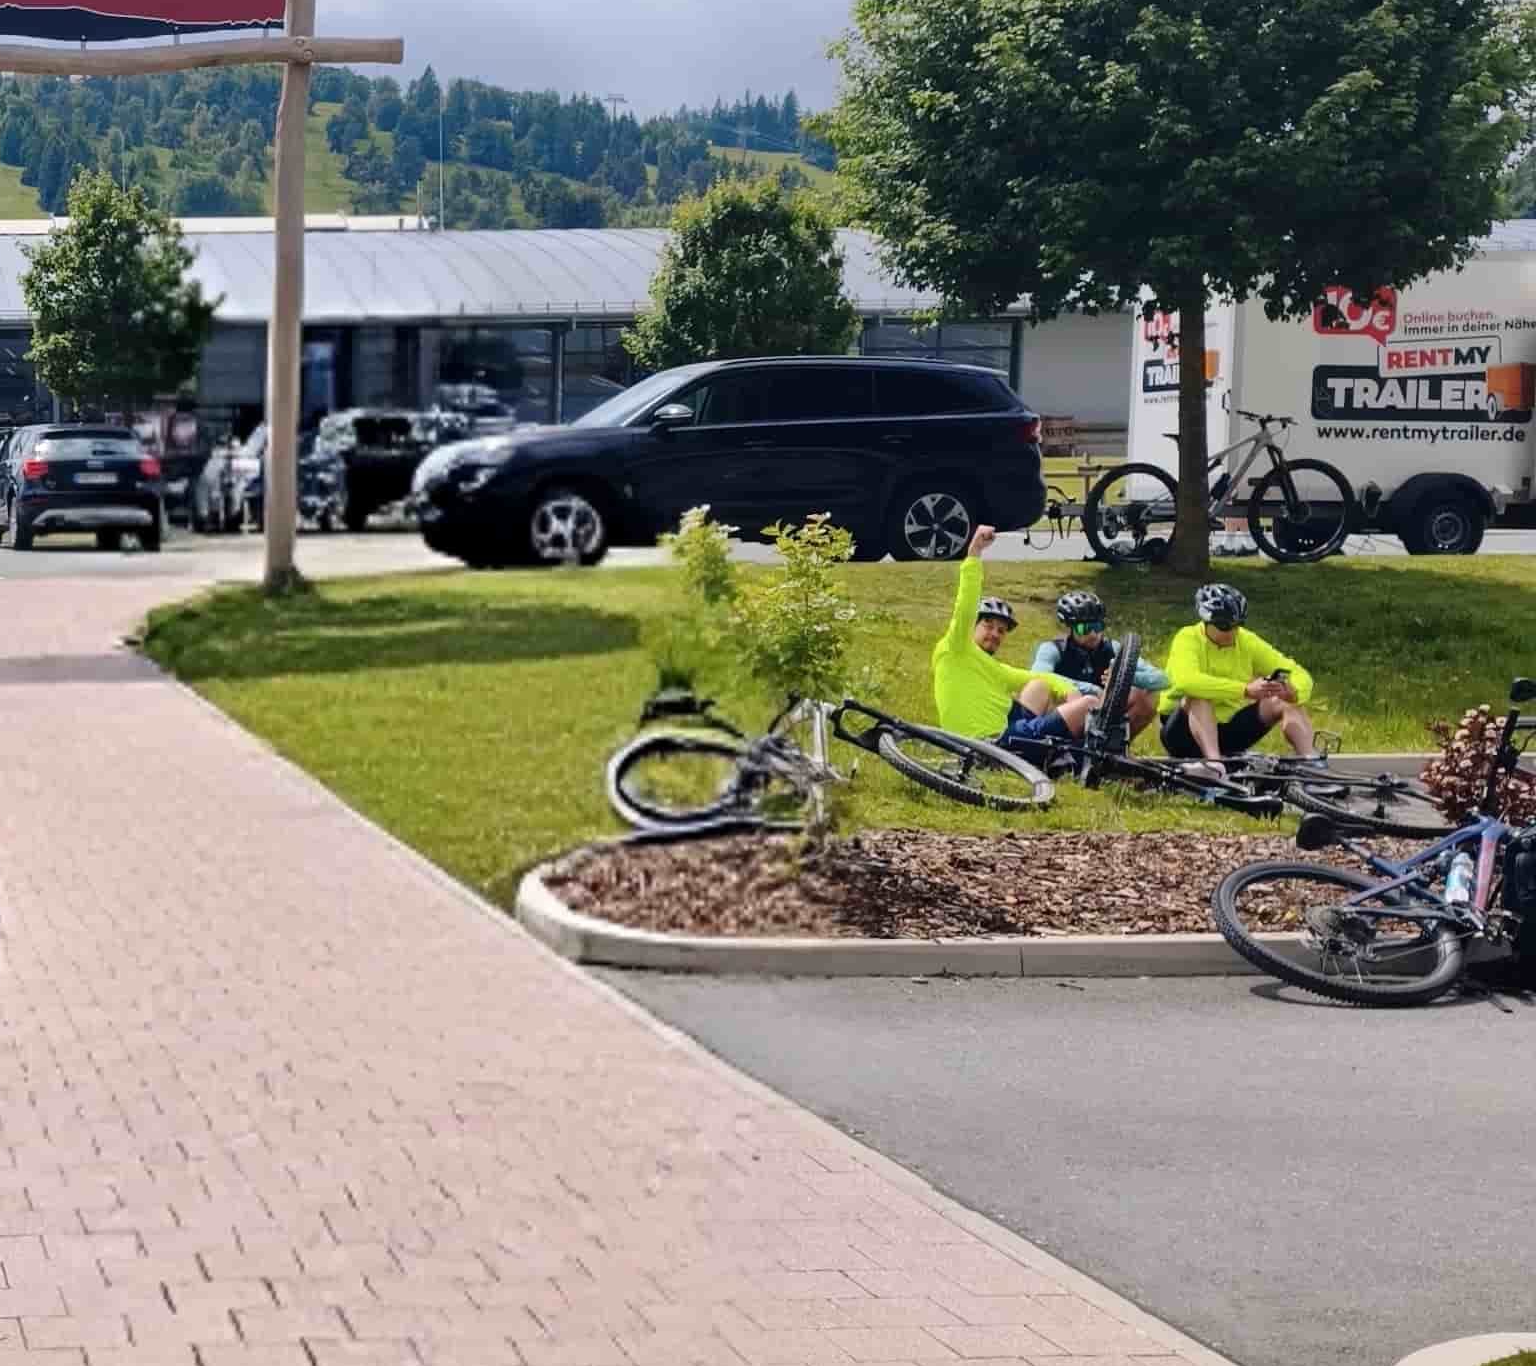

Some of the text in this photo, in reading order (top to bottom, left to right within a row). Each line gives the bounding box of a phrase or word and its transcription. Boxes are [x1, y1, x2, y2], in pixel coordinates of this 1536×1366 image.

[1404, 310, 1443, 324] Online
[1404, 323, 1444, 334] Immer
[1448, 320, 1459, 332] in
[1463, 320, 1500, 332] deiner
[1327, 378, 1488, 411] TRAILER
[1317, 425, 1526, 443] www.rentmytrailer.de
